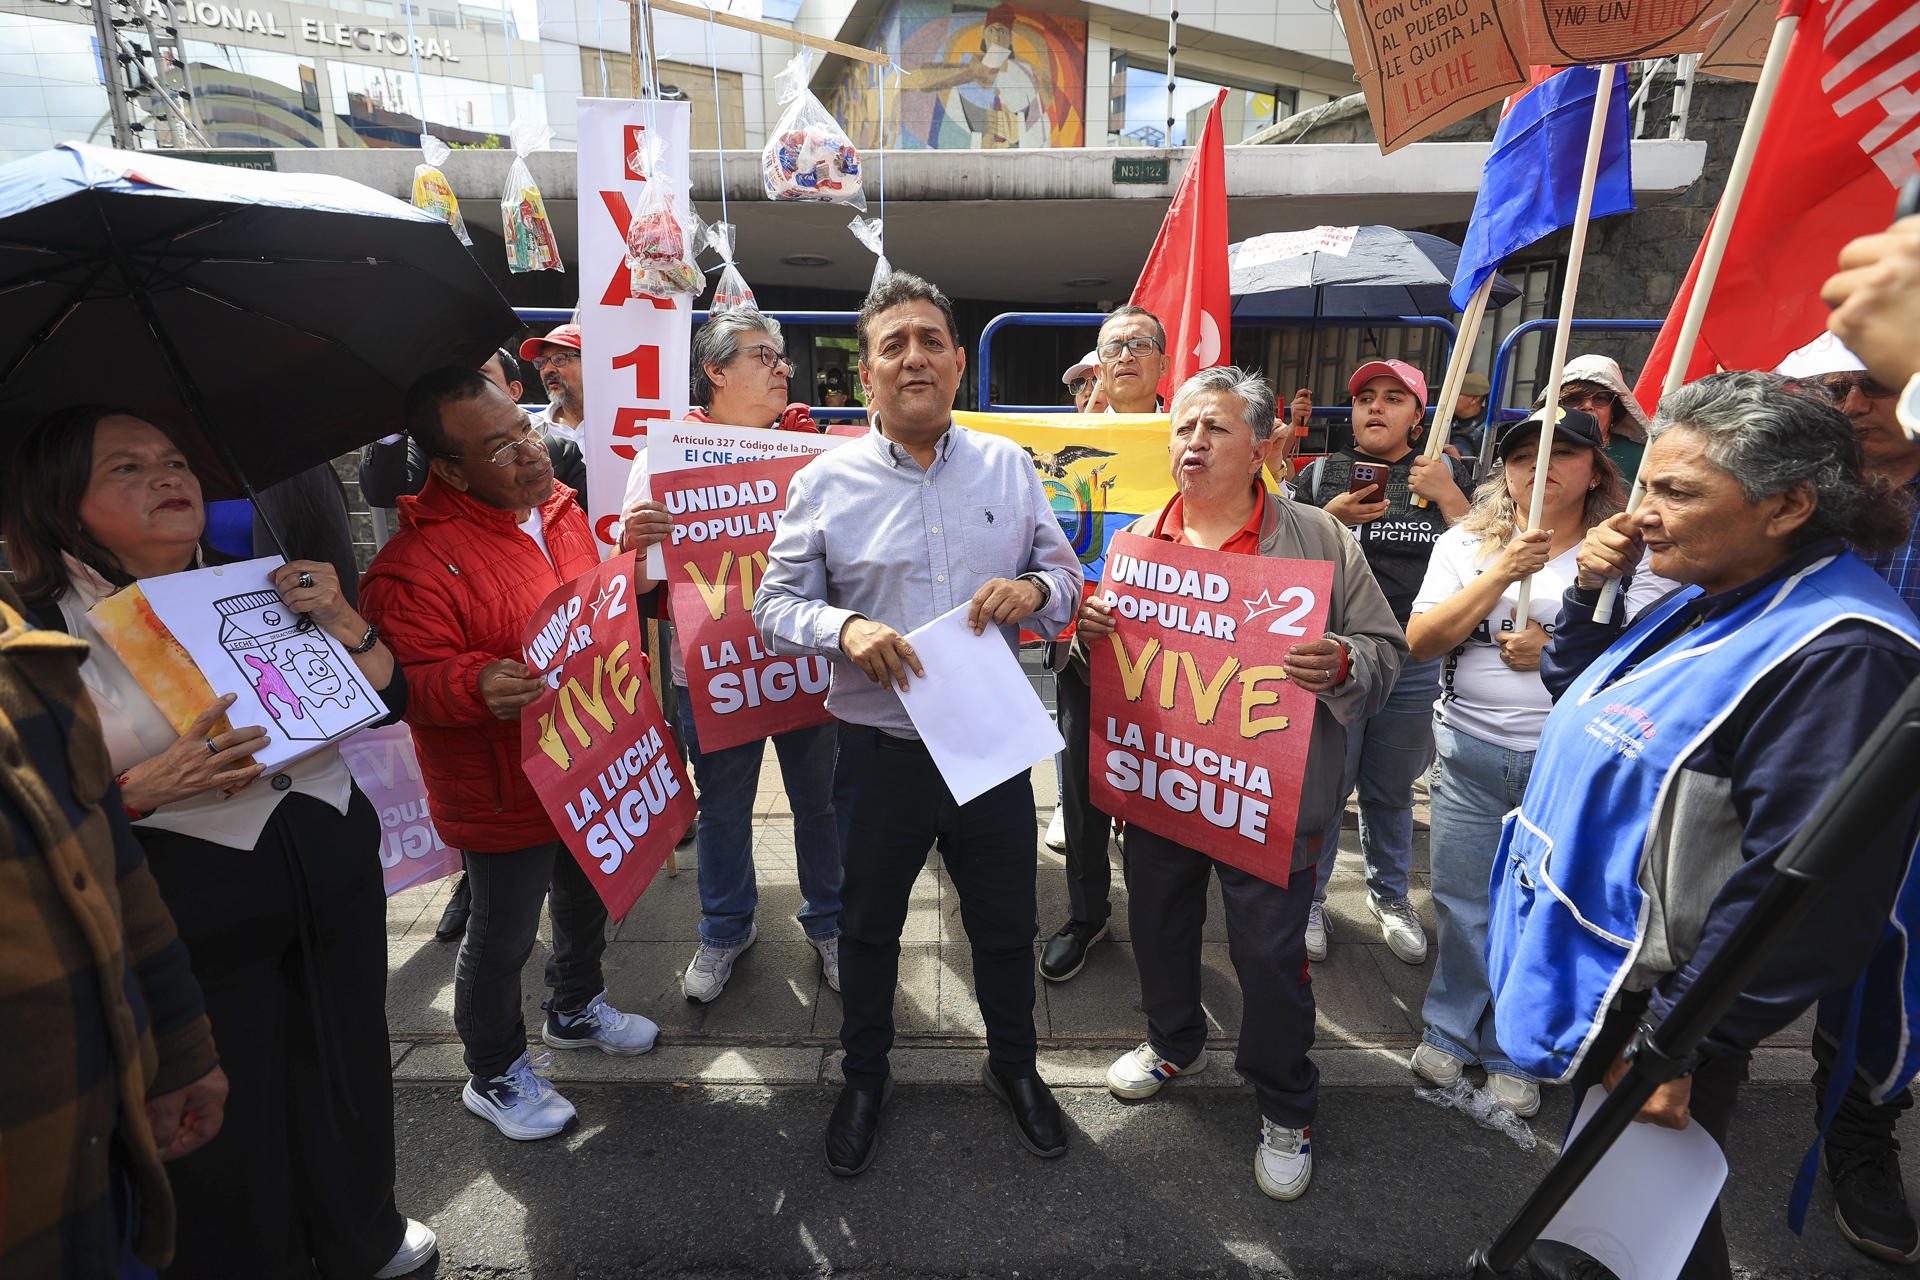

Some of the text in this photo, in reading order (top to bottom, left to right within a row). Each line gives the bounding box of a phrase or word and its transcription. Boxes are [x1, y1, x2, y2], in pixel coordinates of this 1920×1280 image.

[119, 0, 460, 63] AIONAL ELECTORAL
[1374, 2, 1404, 30] CON
[1382, 0, 1468, 55] AL PUEBLO
[1598, 1, 1631, 23] UN
[1386, 11, 1494, 80] LE QUITA LA
[1402, 50, 1479, 114] LECHE
[672, 434, 828, 455] Artículo 327 Código de la Demo
[685, 449, 698, 462] El
[702, 451, 733, 465] CNE
[664, 479, 778, 515] UNIDAD
[1371, 521, 1432, 531] BANCO
[607, 574, 628, 620] 2
[1110, 553, 1230, 603] UNIDAD
[528, 595, 582, 670] UNIDAD
[1103, 589, 1238, 642] POPULAR
[1267, 586, 1316, 637] 2
[230, 640, 254, 650] LECHE
[700, 641, 741, 671] LA
[708, 656, 831, 715] SIGU
[1108, 632, 1290, 739] VIVE
[564, 725, 664, 832] LA LUCHA
[1107, 716, 1273, 798] LA LUCHA
[586, 753, 681, 875] SIGUE
[1105, 750, 1270, 845] SIGUE
